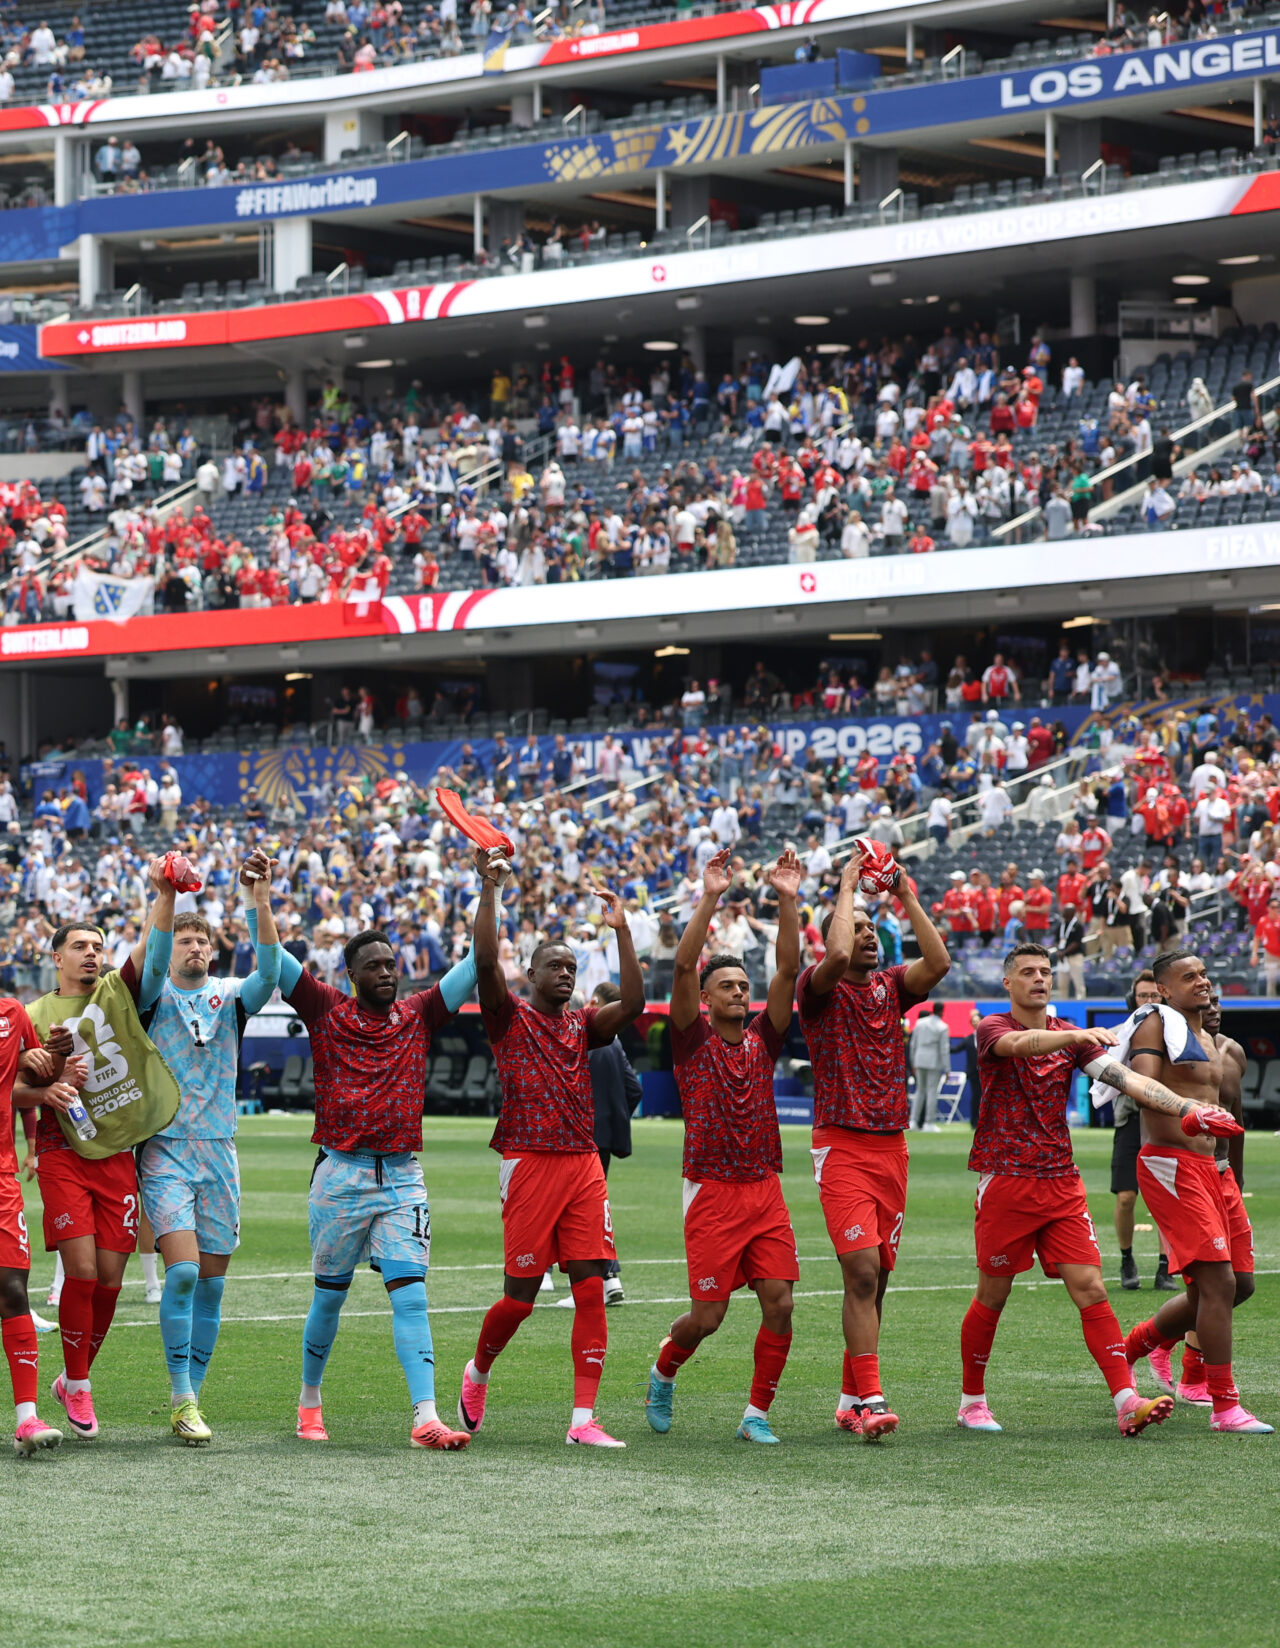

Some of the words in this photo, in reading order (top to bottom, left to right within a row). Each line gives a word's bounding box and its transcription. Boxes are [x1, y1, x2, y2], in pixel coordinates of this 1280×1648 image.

[1001, 65, 1103, 108] LOS
[236, 176, 377, 216] #FIFAWorldCup
[896, 228, 939, 253] FIFA
[942, 218, 1019, 245] WORLD
[1020, 212, 1062, 236] CUP
[1063, 200, 1141, 230] 2026
[92, 320, 186, 346] SWITZERLAND
[1207, 533, 1259, 560] FIFA
[1, 627, 89, 654] SWITZERLAND
[810, 722, 923, 758] 2026
[191, 1020, 205, 1047] 1
[95, 1067, 117, 1083] FIFA
[89, 1088, 119, 1106] WORLD
[120, 1079, 136, 1091] CUP
[92, 1087, 143, 1119] 2026
[17, 1211, 29, 1244] 9
